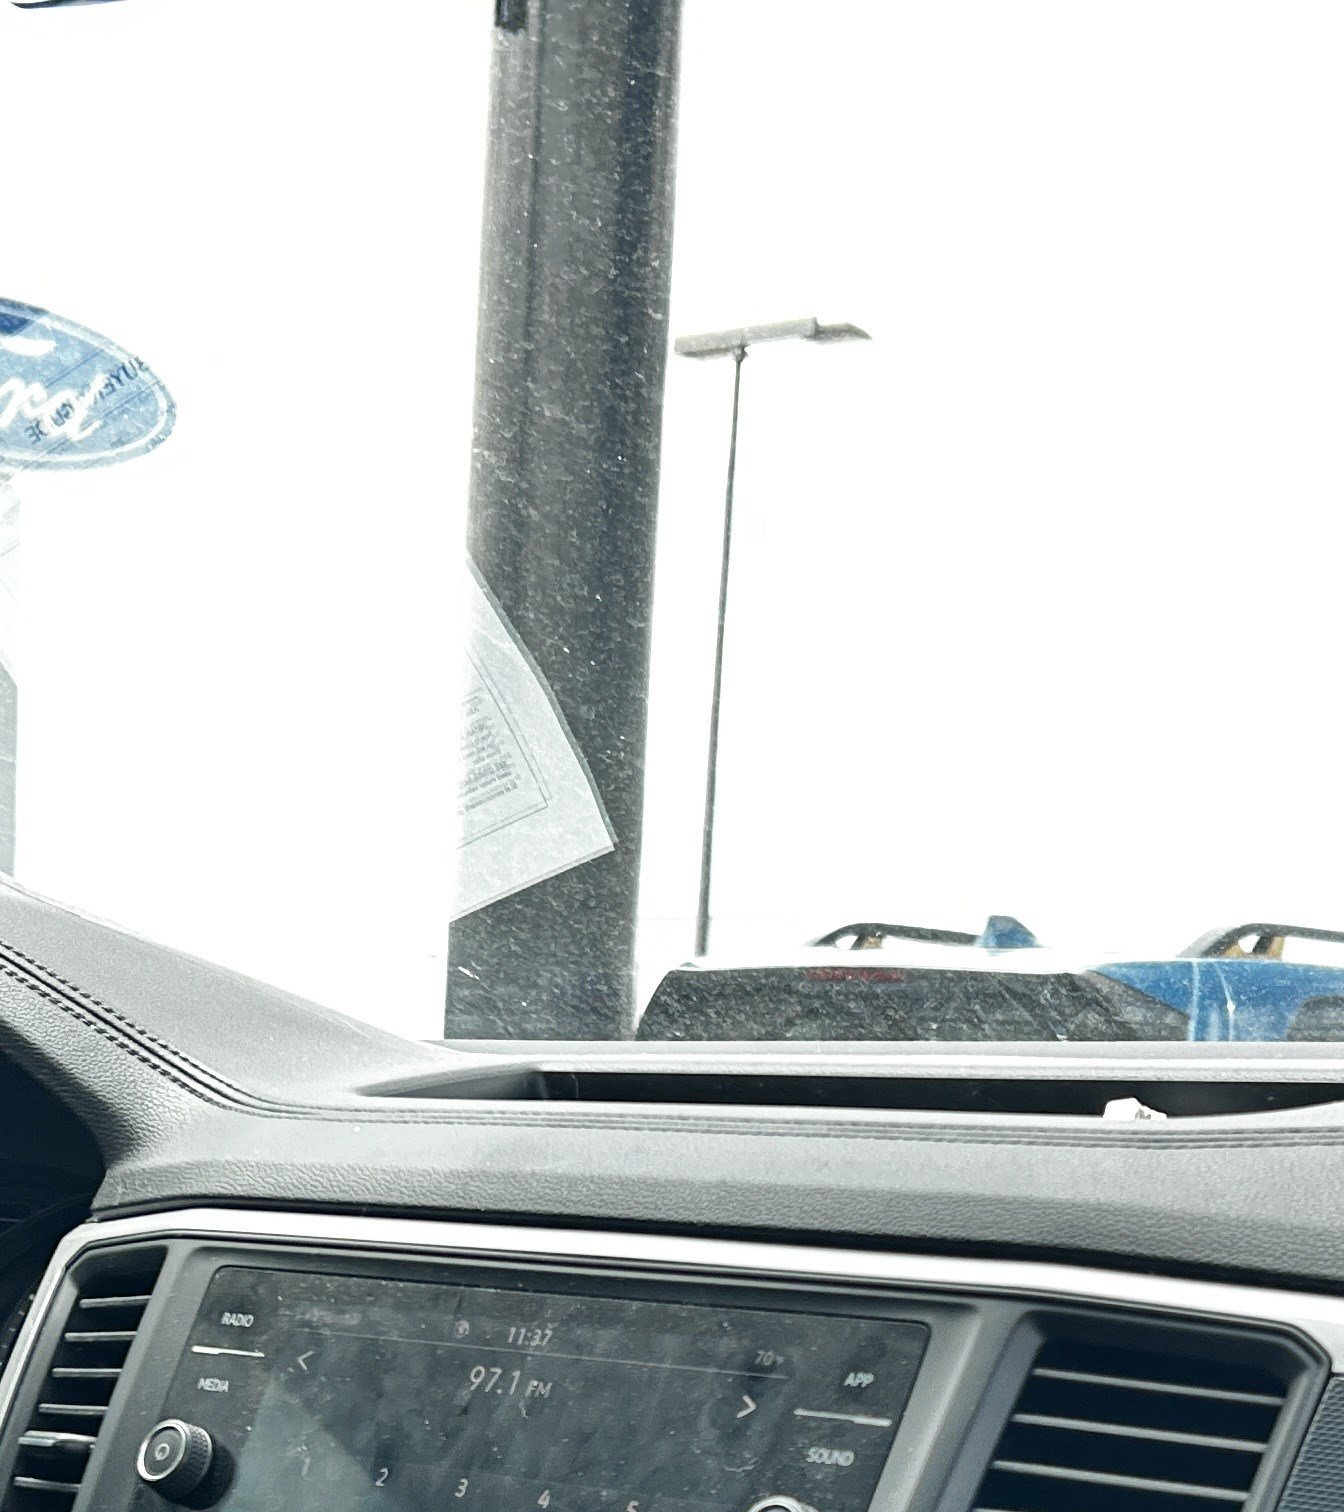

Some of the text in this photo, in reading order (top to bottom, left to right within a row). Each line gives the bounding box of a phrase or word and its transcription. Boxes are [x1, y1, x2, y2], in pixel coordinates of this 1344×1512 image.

[220, 1311, 255, 1328] RADIO
[506, 1326, 553, 1347] 11:37
[196, 1377, 230, 1393] MEDIA
[468, 1365, 554, 1400] 97.1 FM
[843, 1371, 875, 1389] APP
[805, 1446, 855, 1467] SOUND
[375, 1467, 390, 1487] 2
[454, 1478, 469, 1499] 3
[537, 1490, 551, 1509] 4
